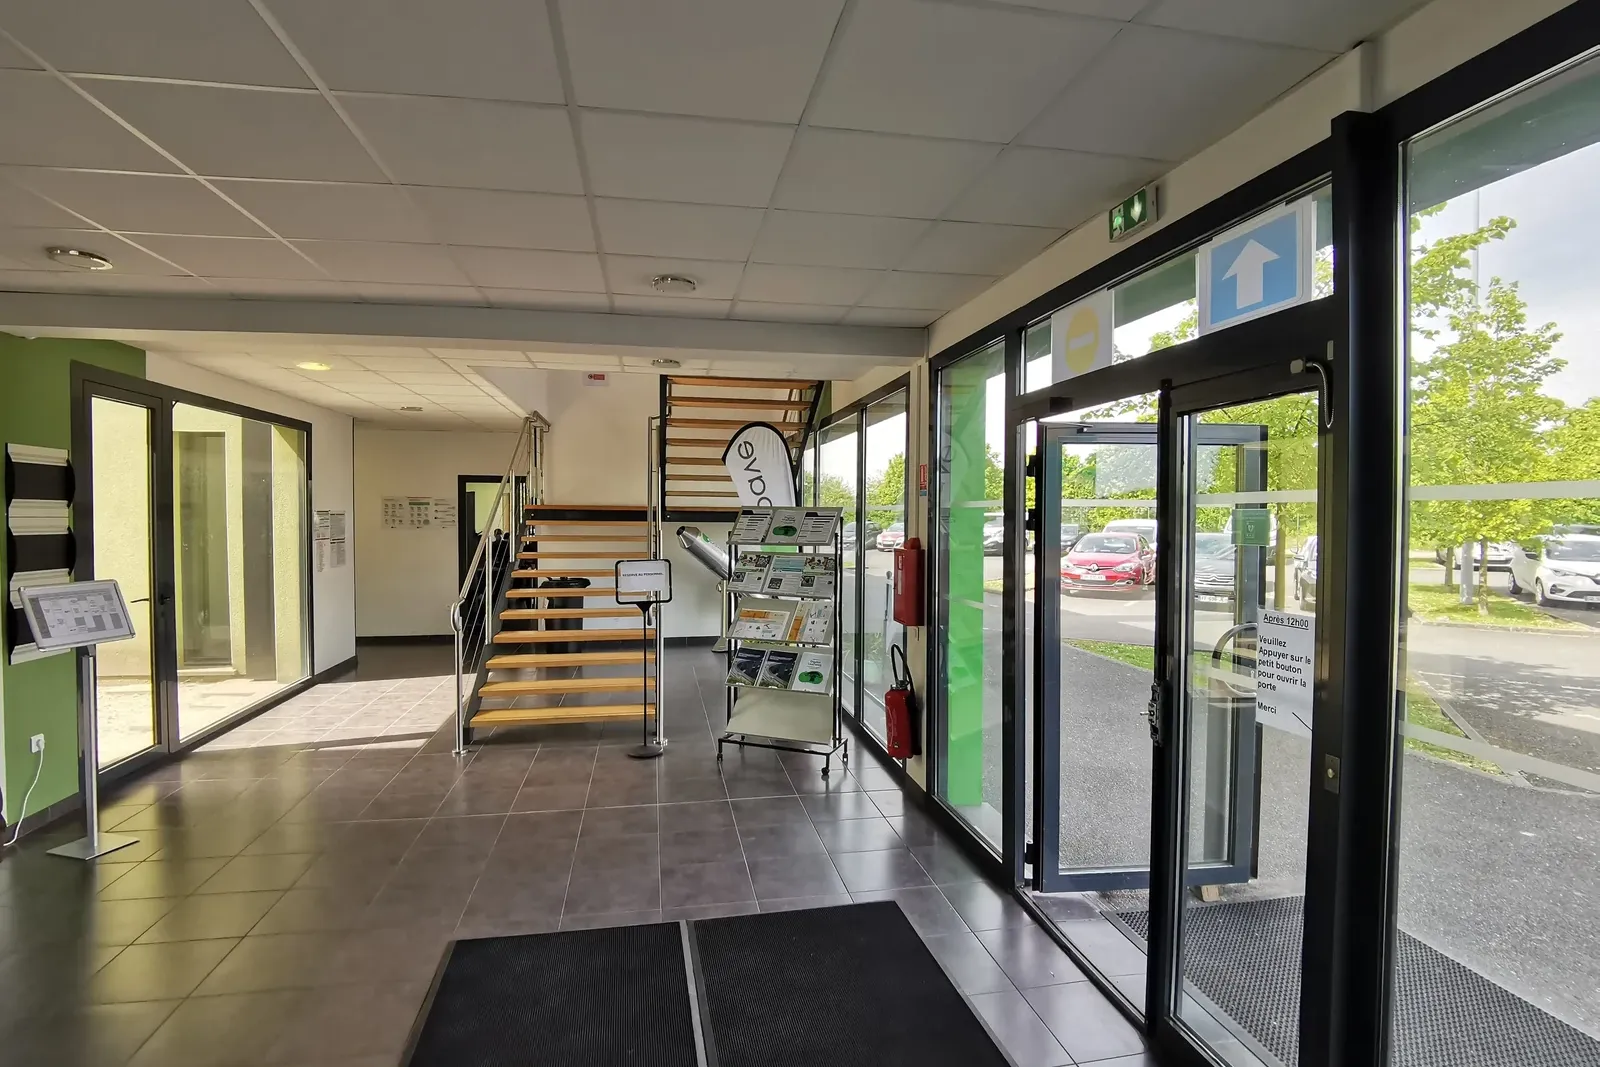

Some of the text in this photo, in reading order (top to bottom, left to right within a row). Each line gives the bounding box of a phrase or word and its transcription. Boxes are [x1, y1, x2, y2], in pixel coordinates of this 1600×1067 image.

[1263, 613, 1309, 628] Après 12h00
[1259, 635, 1287, 648] Veuillez
[1259, 646, 1311, 665] Appuyer sur le
[1258, 659, 1302, 674] petit bouton
[1257, 681, 1277, 692] porte
[1258, 670, 1307, 688] pour ouvrir la
[1257, 701, 1277, 714] Merci
